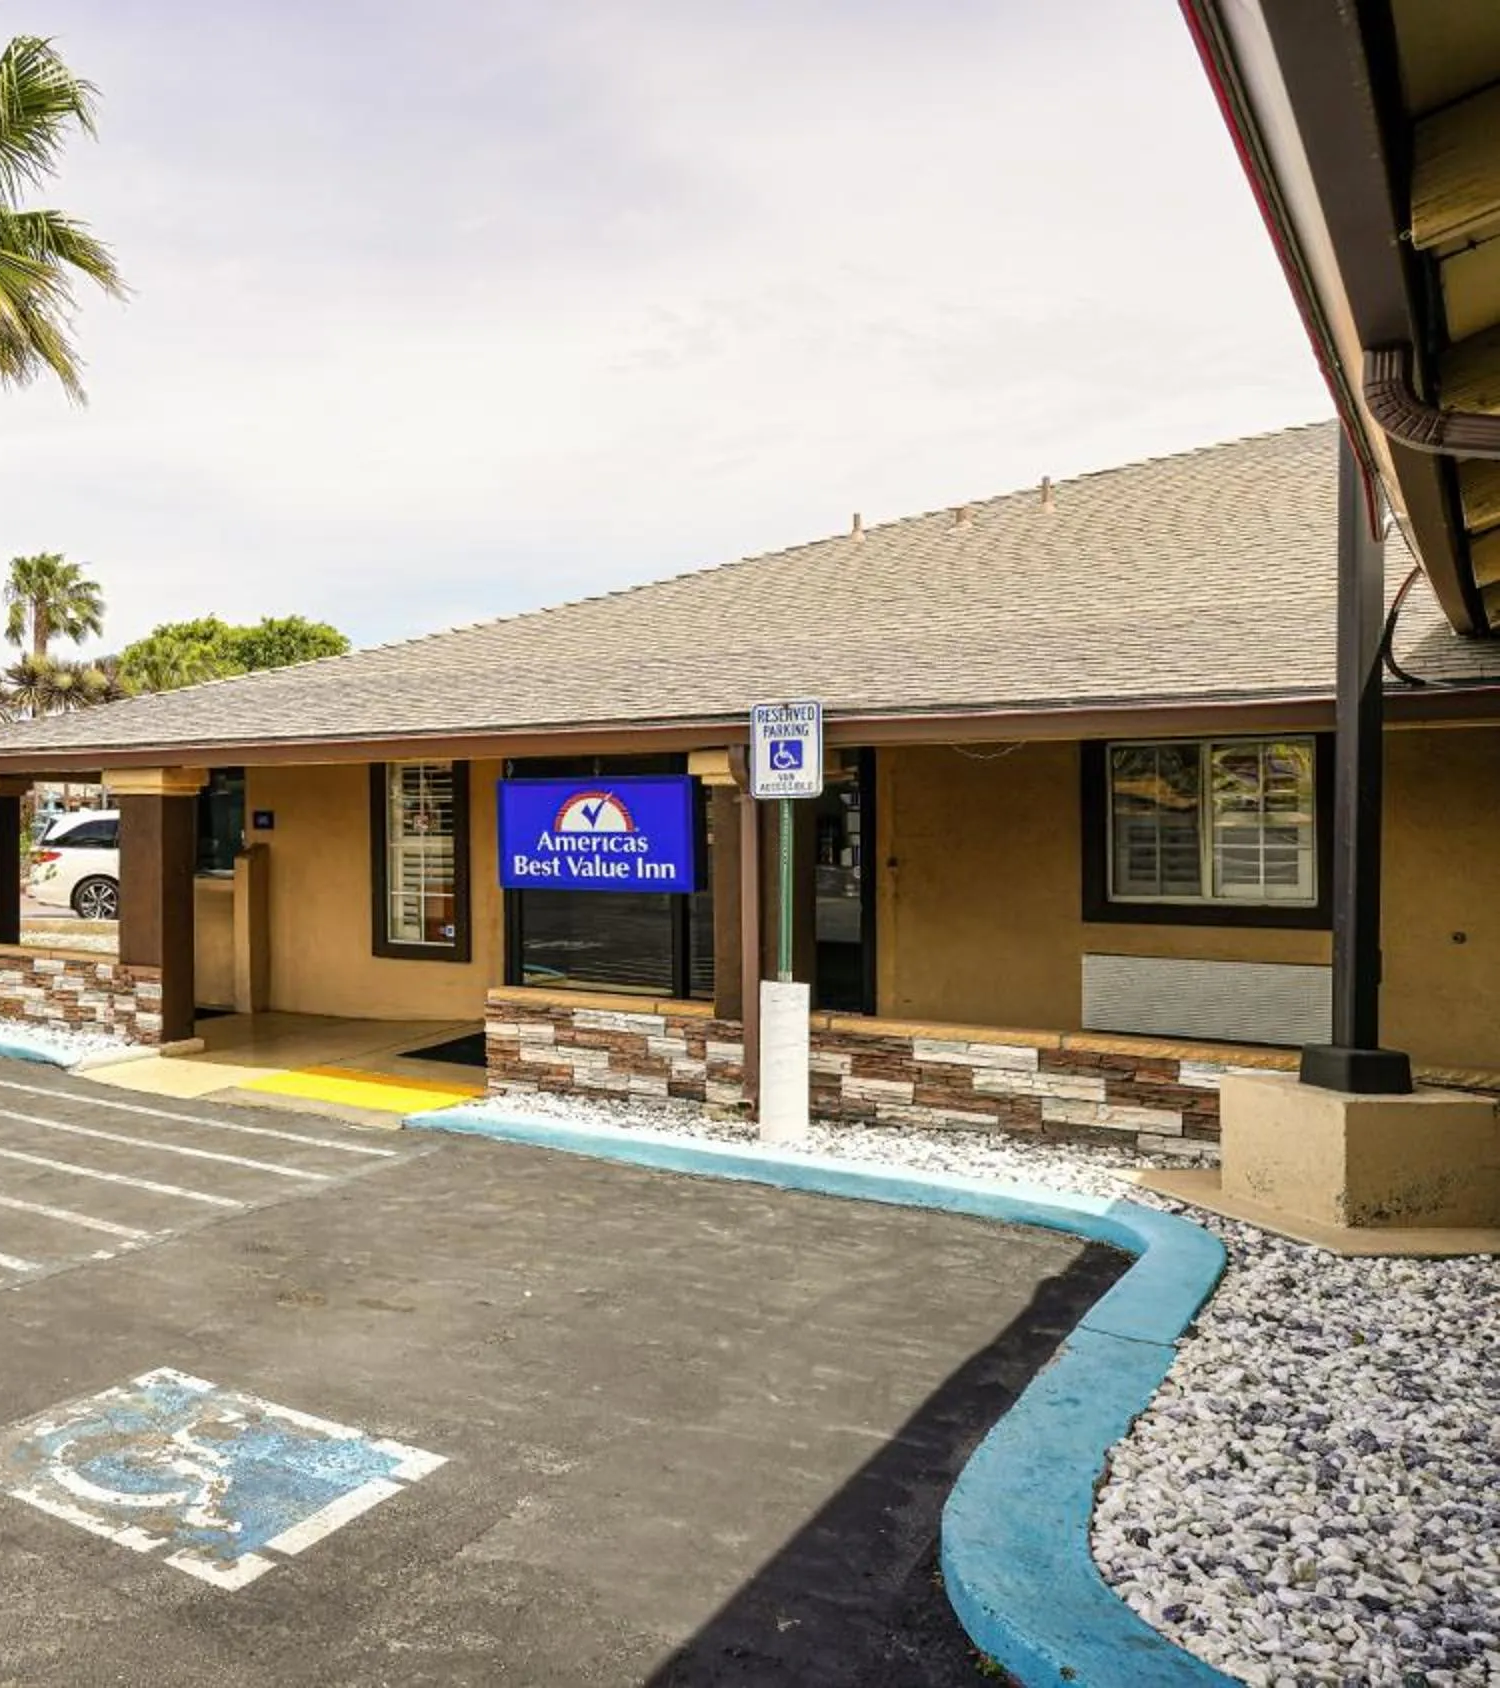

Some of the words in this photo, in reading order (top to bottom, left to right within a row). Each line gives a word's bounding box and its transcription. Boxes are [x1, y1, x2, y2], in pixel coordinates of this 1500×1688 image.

[757, 706, 815, 722] RESERVED
[763, 723, 809, 738] PARKING
[537, 831, 649, 853] Americas
[513, 855, 561, 876] Best
[565, 856, 631, 878] Value
[637, 857, 676, 879] Inn
